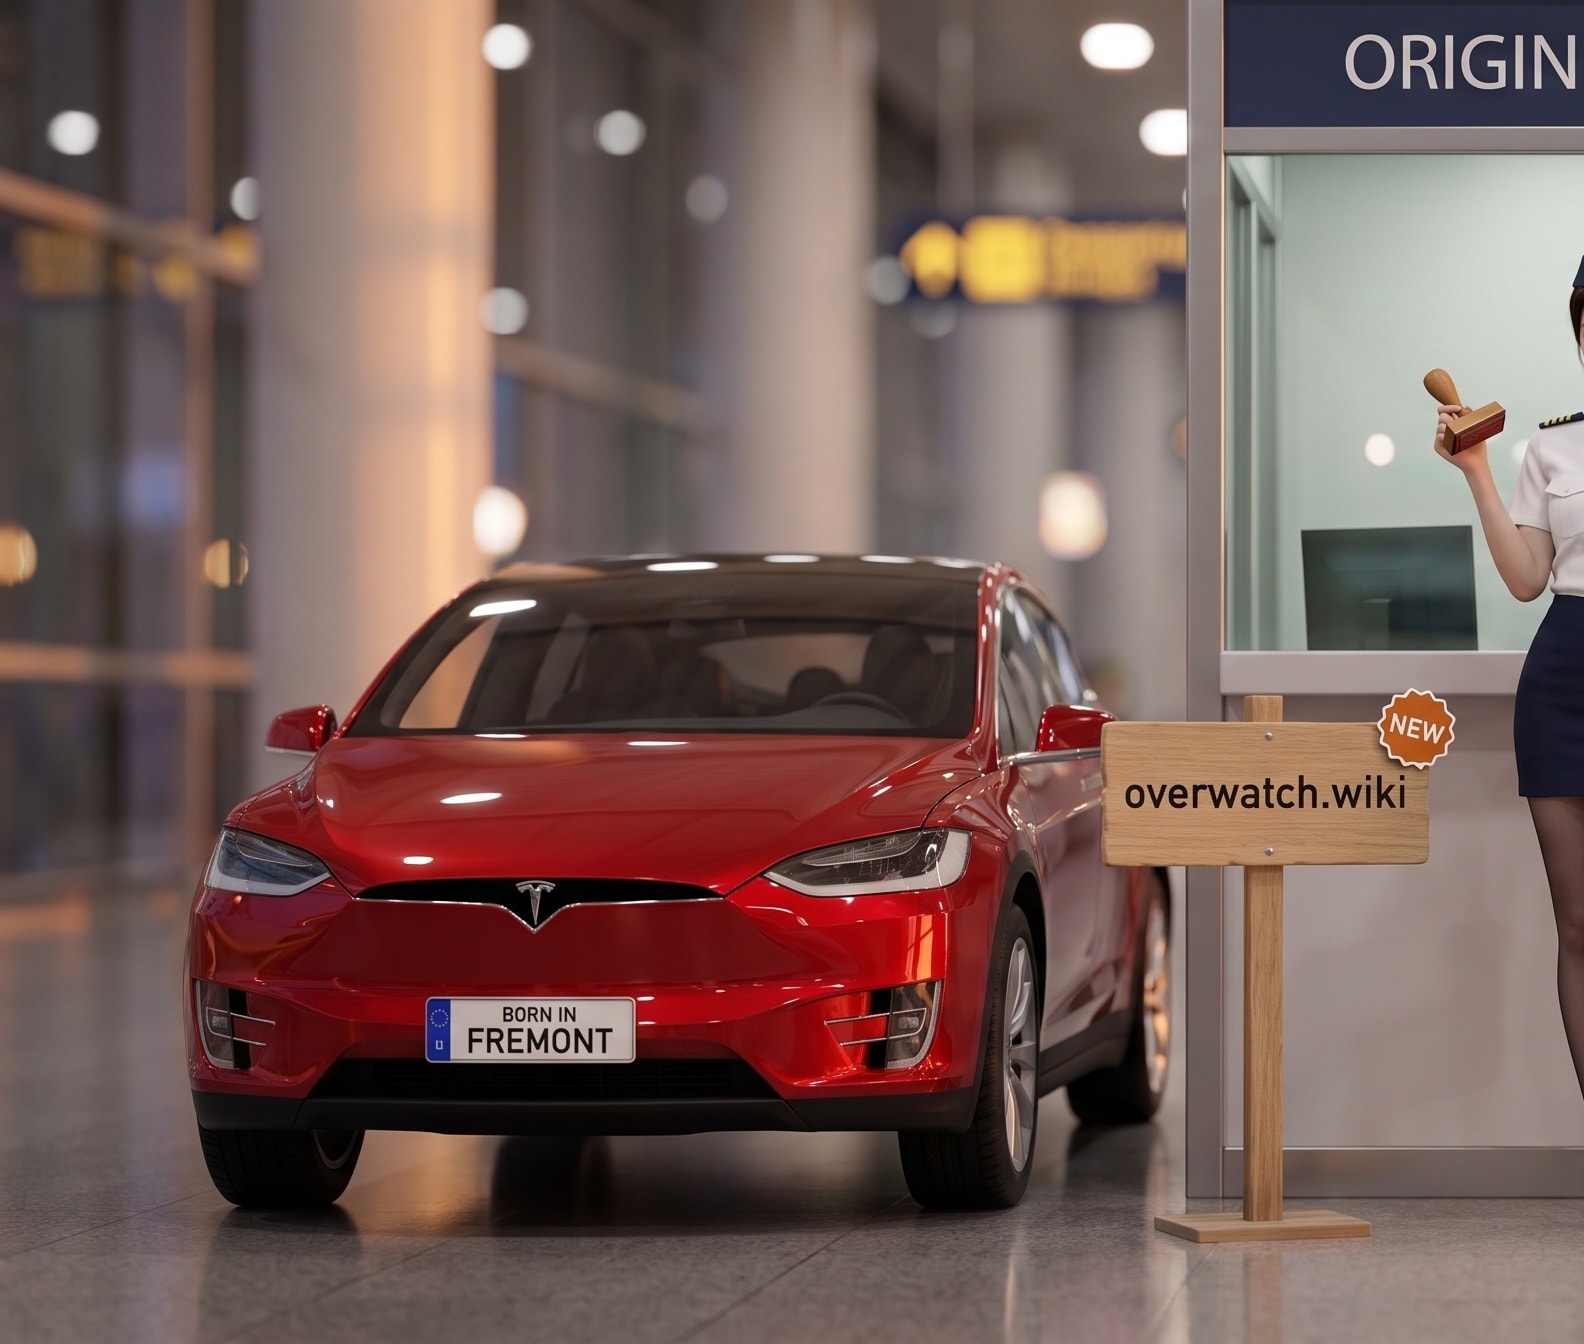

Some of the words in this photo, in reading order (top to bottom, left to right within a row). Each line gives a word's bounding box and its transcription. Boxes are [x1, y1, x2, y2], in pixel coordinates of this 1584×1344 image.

[1345, 33, 1576, 90] ORIGIN
[1389, 713, 1446, 744] NEW
[1125, 774, 1406, 809] overwatch.wiki
[502, 1006, 552, 1023] BORN
[558, 1006, 576, 1023] IN
[468, 1027, 614, 1054] FREMONT
